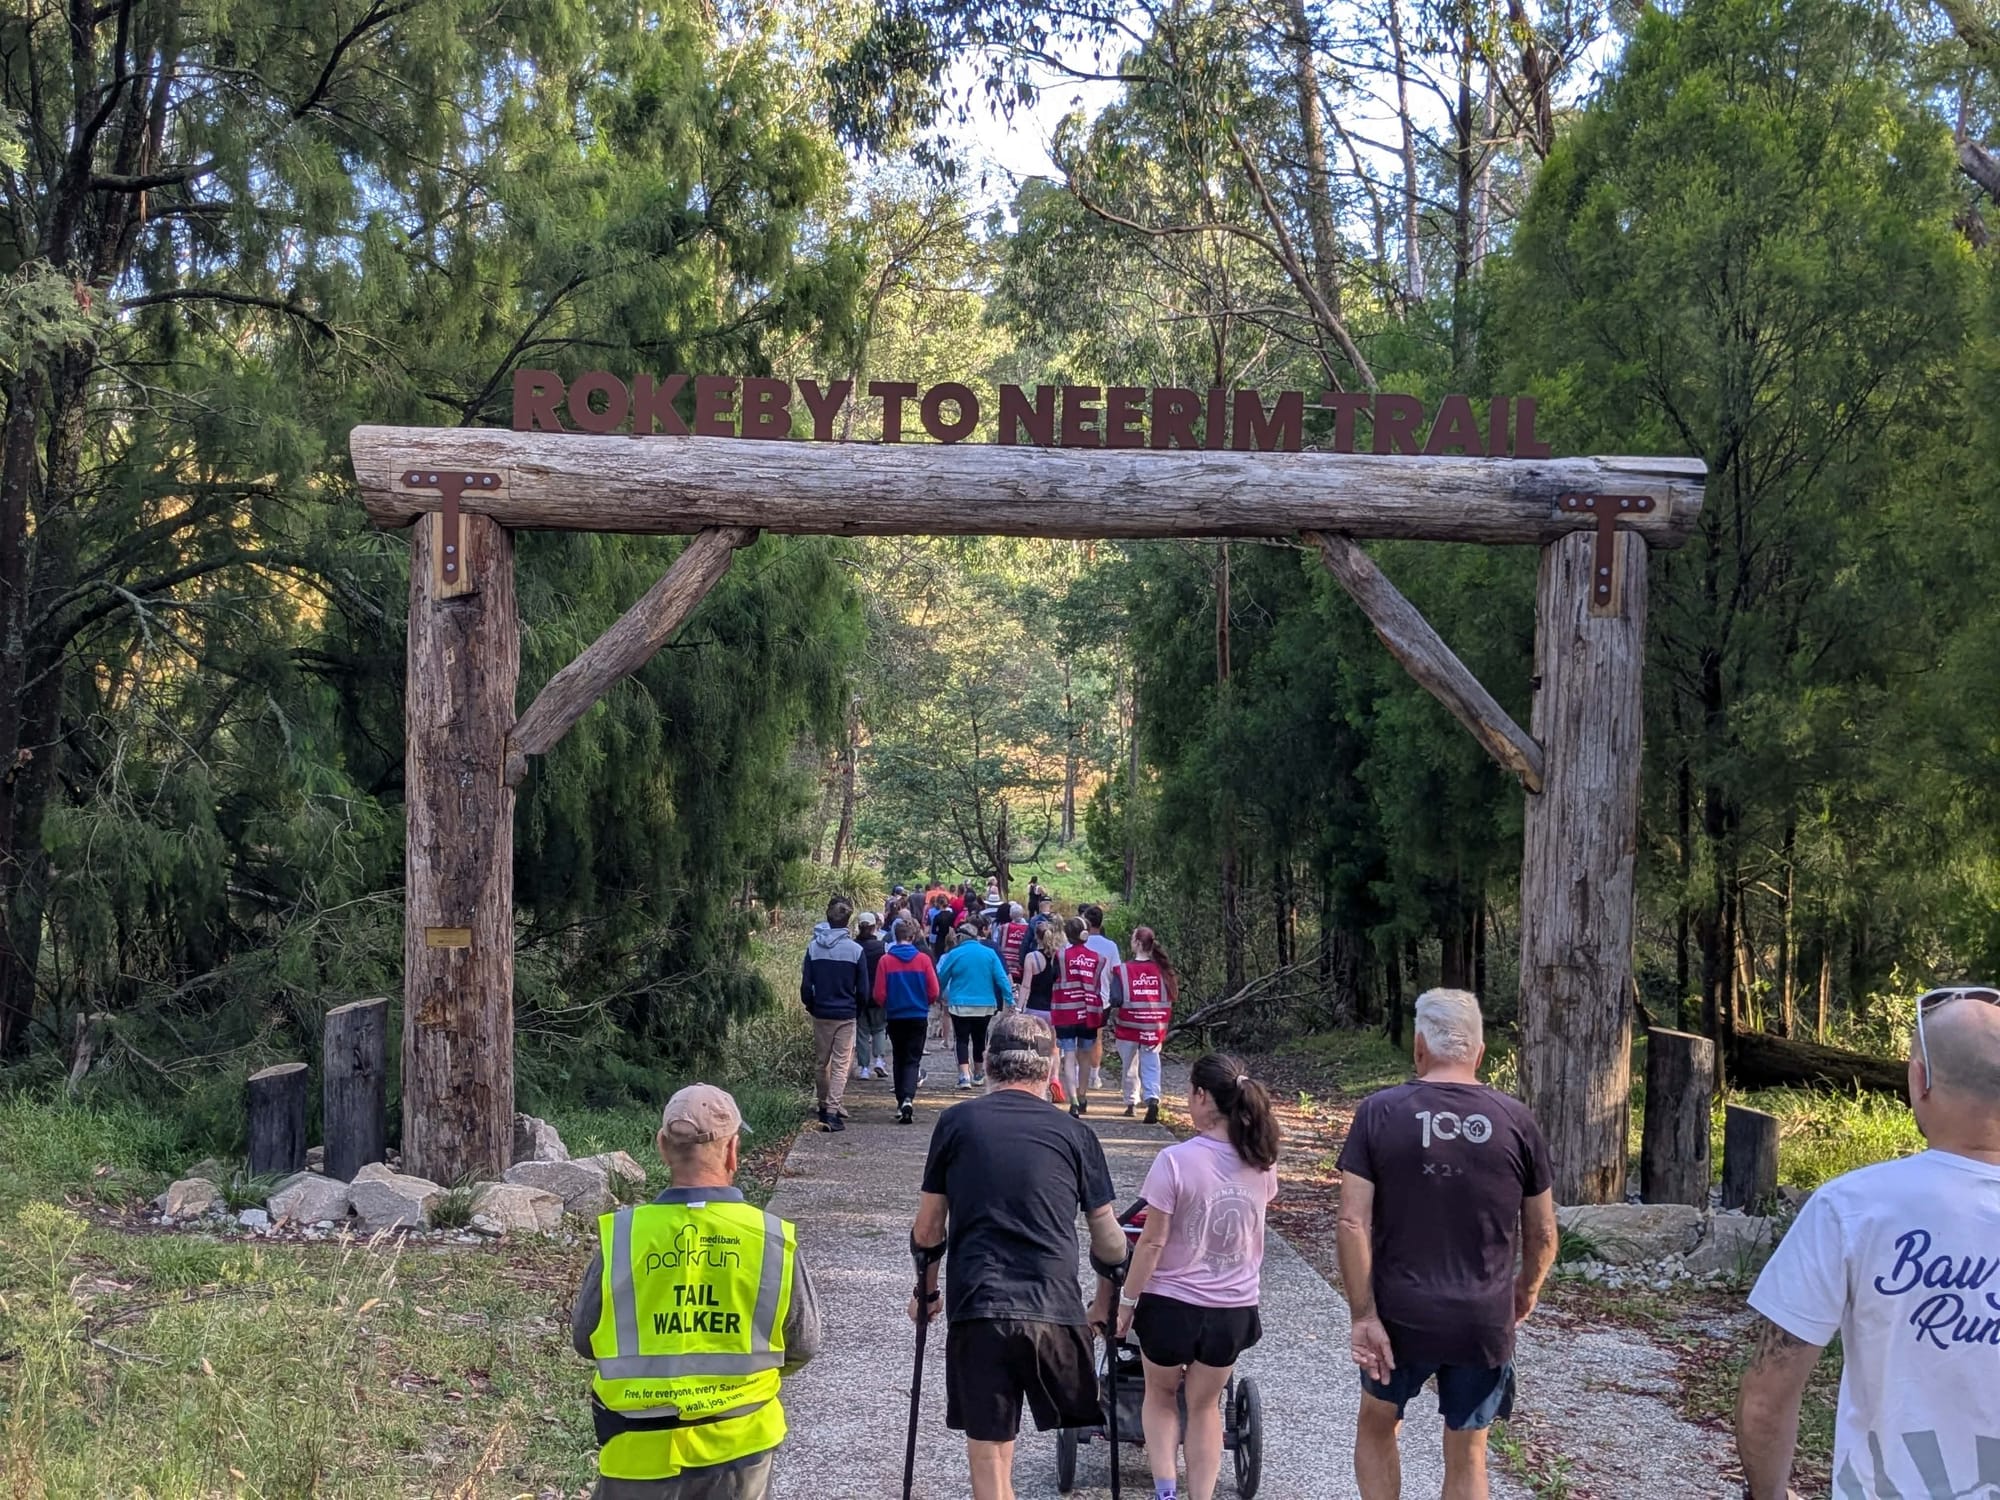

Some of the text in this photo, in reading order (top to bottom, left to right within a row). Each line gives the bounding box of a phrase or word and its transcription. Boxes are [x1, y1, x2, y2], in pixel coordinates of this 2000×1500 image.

[513, 369, 1552, 460] ROKEBY TO NEERIM TRAIL
[1415, 1110, 1493, 1148] 100
[646, 1224, 740, 1276] parkrun
[700, 1235, 741, 1245] medibank
[1874, 1229, 2000, 1296] Baw
[673, 1284, 719, 1307] TAIL
[653, 1312, 741, 1335] WALKER
[624, 1389, 642, 1400] Free,
[642, 1388, 653, 1398] for
[655, 1387, 695, 1400] everyone,
[694, 1383, 717, 1395] every
